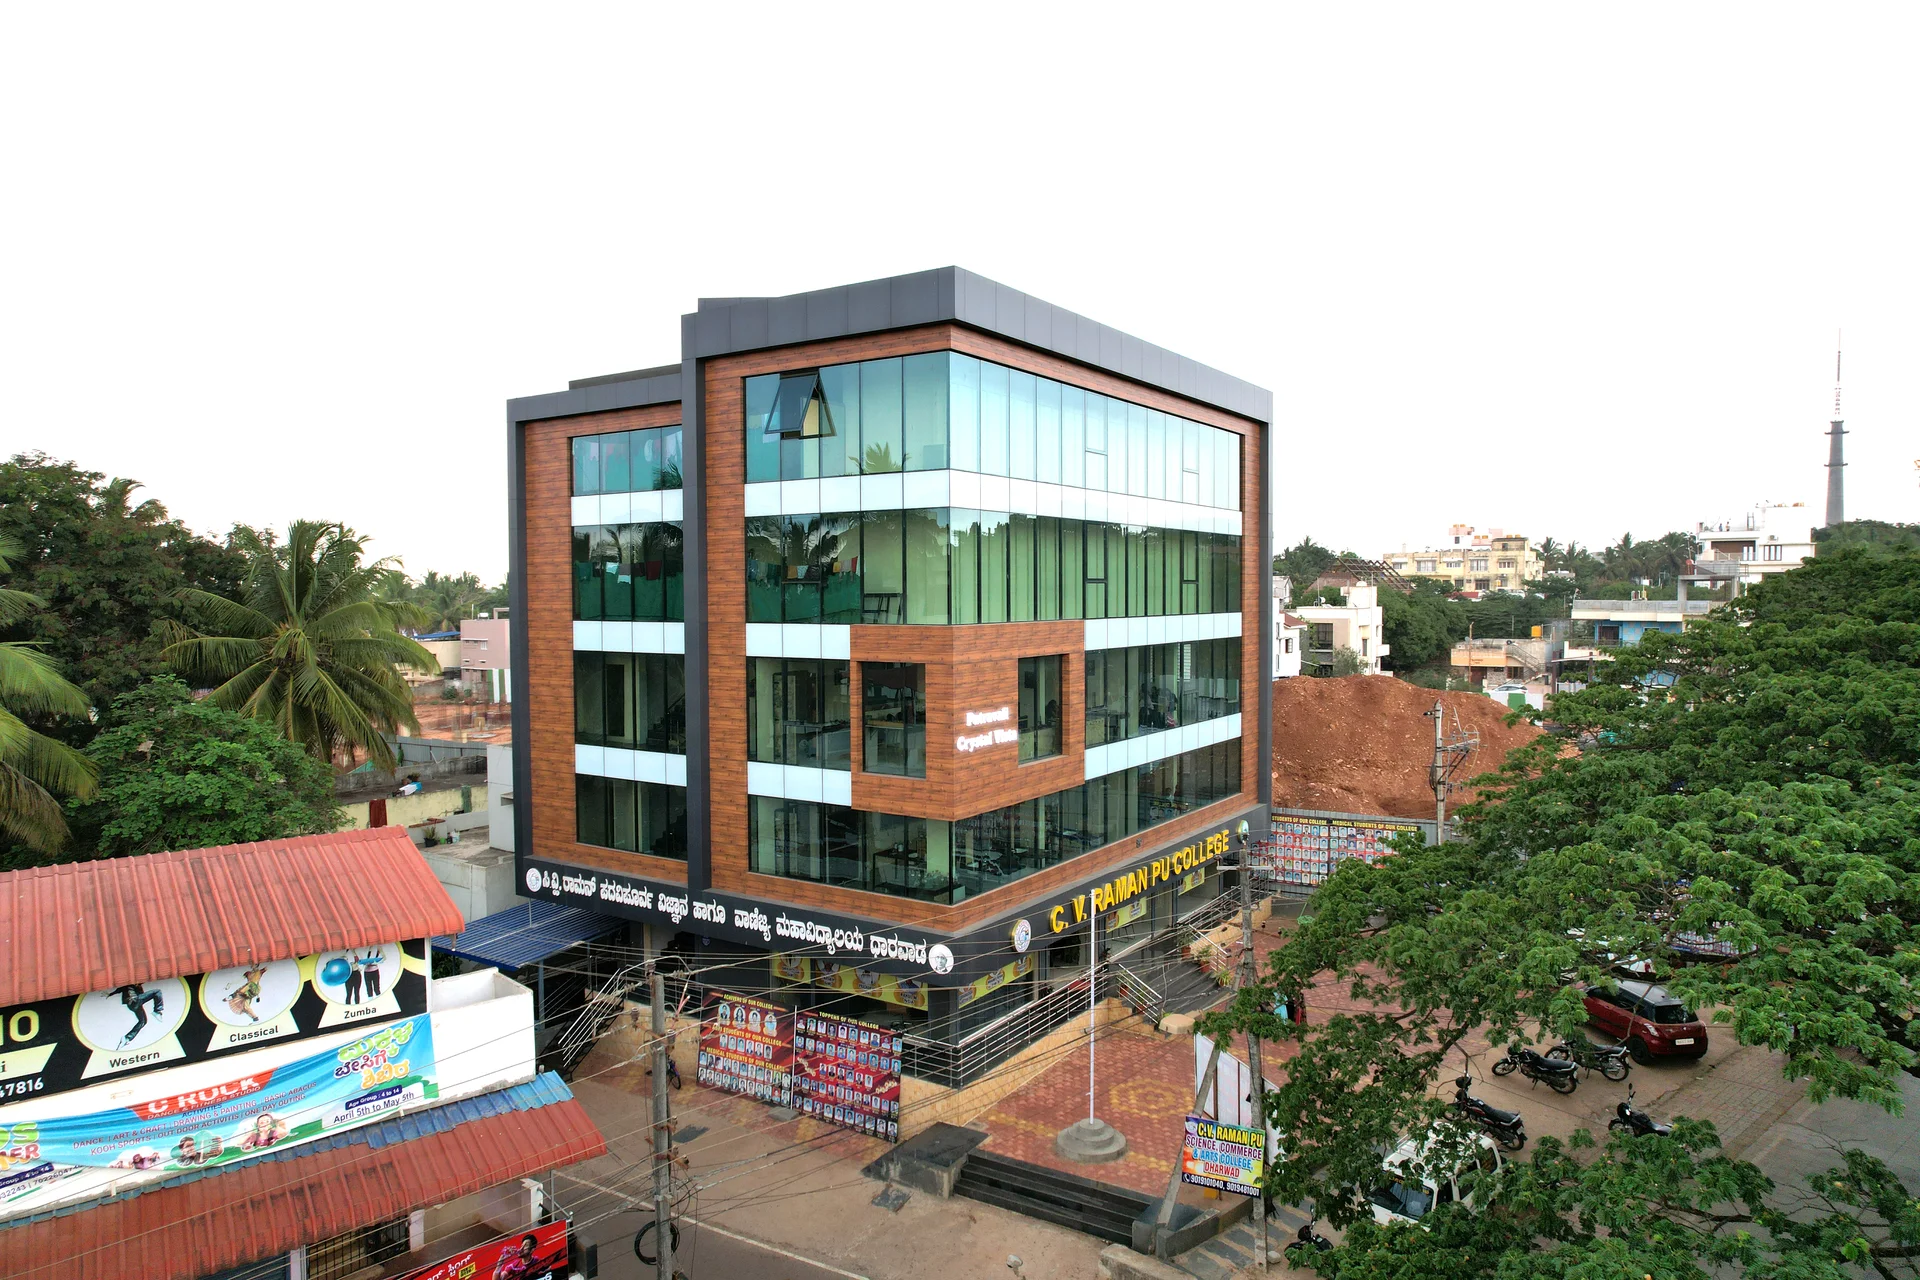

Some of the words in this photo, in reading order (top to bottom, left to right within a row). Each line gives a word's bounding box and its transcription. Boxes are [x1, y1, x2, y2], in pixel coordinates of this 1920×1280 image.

[1354, 821, 1377, 829] STUDENTS
[1093, 866, 1148, 915] RAMAN
[1151, 857, 1170, 887] PU
[1173, 829, 1230, 875] COLLEGE
[692, 898, 726, 925] ಹಾಗೂ
[869, 932, 927, 965] ಧಾರವಾಡ
[344, 1006, 377, 1019] Zumba
[757, 1001, 773, 1010] COLLEGE
[819, 1011, 840, 1021] TOPPERS
[859, 1020, 879, 1030] COLLEGE
[229, 1025, 279, 1043] Classical
[723, 1026, 745, 1038] STUDENTS
[752, 1034, 762, 1042] OUR
[763, 1036, 782, 1046] COLLEGE
[109, 1051, 160, 1069] Western
[706, 1046, 726, 1057] MEDICAL
[726, 1052, 748, 1062] STUDENTS
[755, 1058, 765, 1067] OUR
[765, 1061, 785, 1072] COLLEGE
[147, 1108, 180, 1120] DANCE
[190, 1096, 228, 1111] FITNESS
[230, 1086, 261, 1099] STUDIO
[333, 1108, 355, 1124] April
[356, 1105, 370, 1116] 5th
[372, 1104, 382, 1112] to
[383, 1098, 400, 1109] May
[402, 1091, 415, 1102] 5th
[348, 1100, 359, 1108] Age
[360, 1095, 378, 1103] Group
[73, 1136, 104, 1149] DANCE
[112, 1131, 130, 1141] ART
[140, 1123, 167, 1135] CRAFT
[173, 1112, 211, 1128] DRAWING
[220, 1099, 257, 1115] PAINTING
[264, 1091, 286, 1103] BASIC
[288, 1082, 317, 1096] ABACUS
[181, 1103, 223, 1119] ACTIVITIES
[90, 1143, 116, 1156] KOOH
[118, 1135, 151, 1149] SPORTS
[157, 1130, 174, 1139] OUT
[176, 1124, 200, 1134] DOOR
[244, 1107, 260, 1117] ONE
[262, 1102, 277, 1111] DAY
[278, 1093, 306, 1107] OUTING
[1197, 1122, 1214, 1139] C.V.
[1216, 1125, 1248, 1145] RAMAN
[1250, 1132, 1263, 1148] PU
[1193, 1148, 1199, 1159] &
[1200, 1149, 1219, 1163] ARTS
[1220, 1142, 1262, 1160] COMMERCE
[1204, 1162, 1240, 1178] DHARWAD
[0, 1184, 27, 1200] 32243
